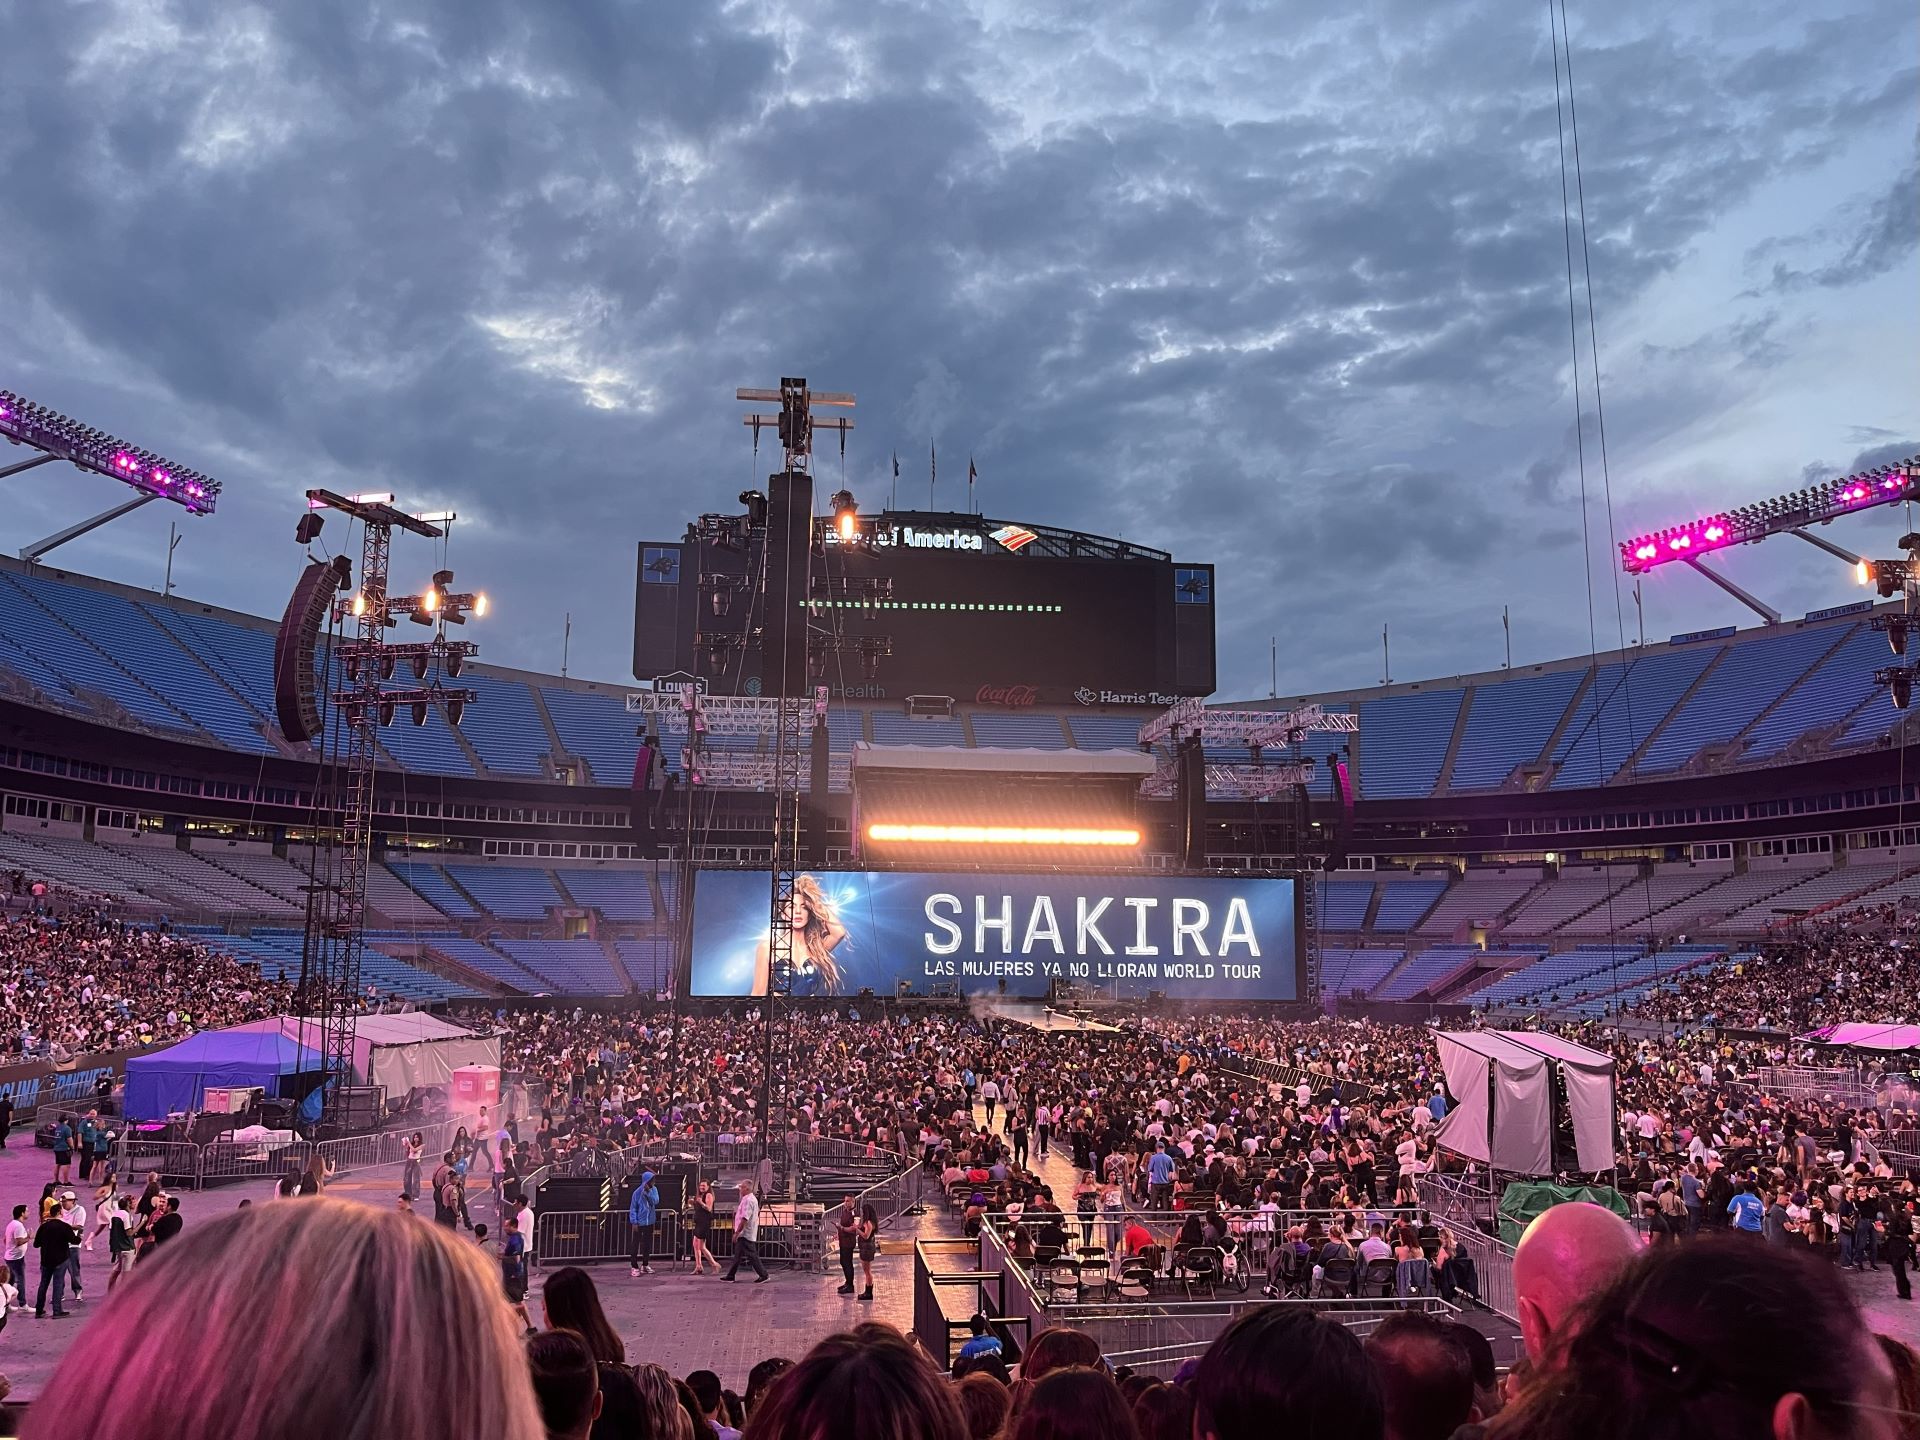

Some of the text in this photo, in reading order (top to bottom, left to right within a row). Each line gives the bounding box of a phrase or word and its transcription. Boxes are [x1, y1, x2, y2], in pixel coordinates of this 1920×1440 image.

[904, 527, 982, 550] America
[832, 682, 885, 699] Health
[1100, 690, 1189, 705] Harris Teete
[924, 893, 1261, 957] SHAKIRA
[924, 960, 1262, 979] LAS MUJERES YA NO LLORAN WORLD TOUR
